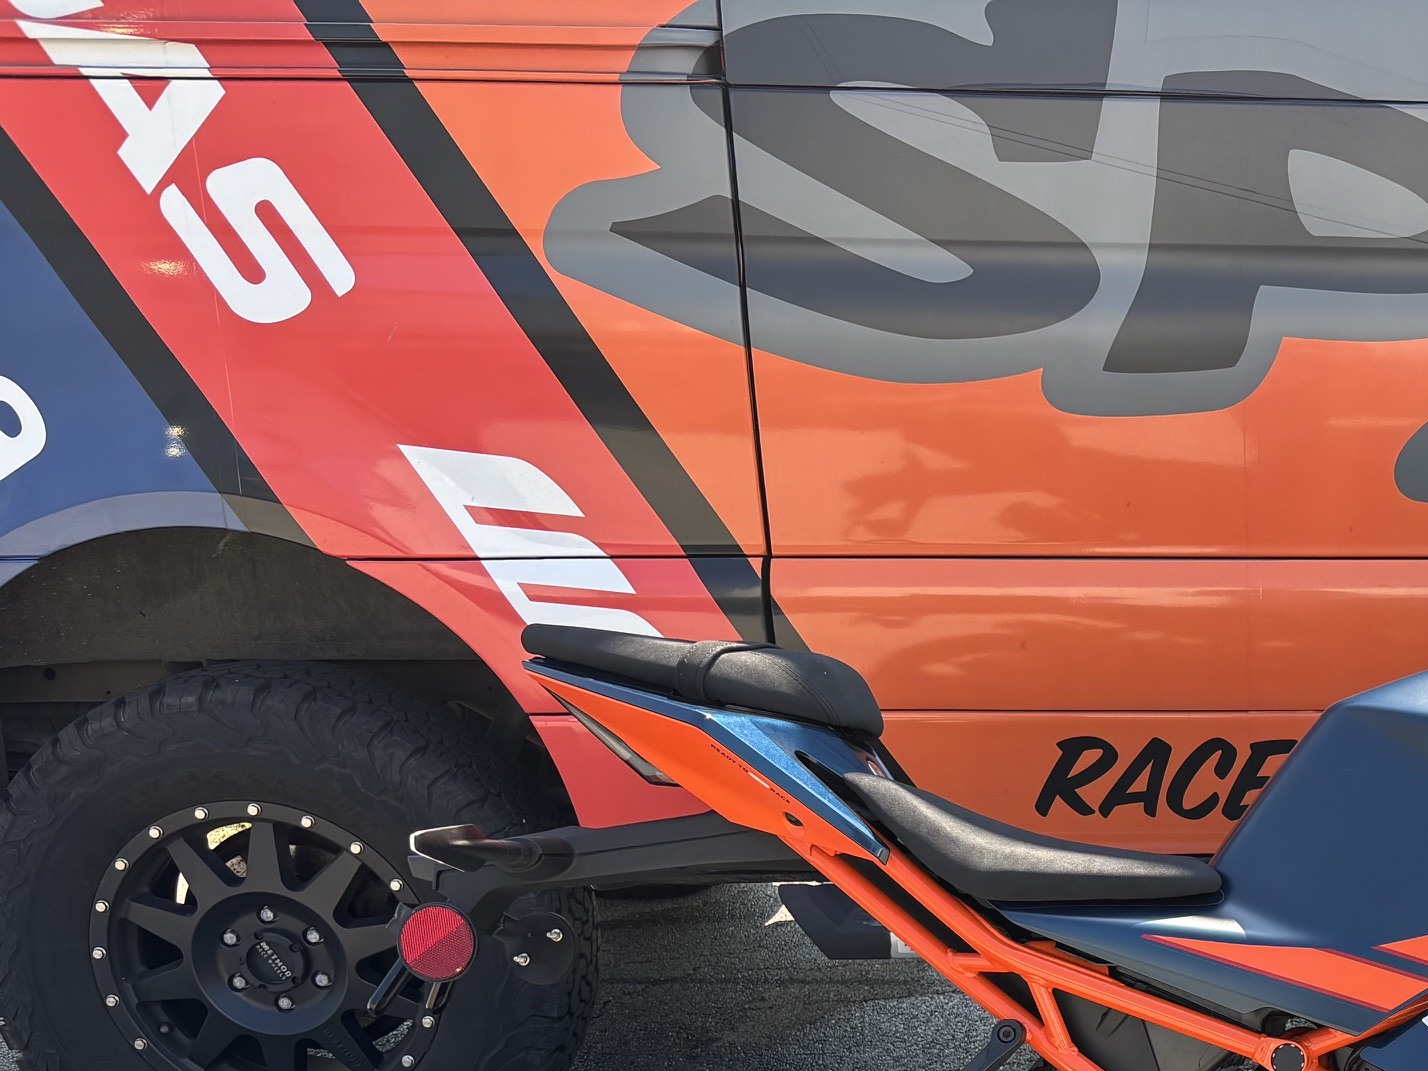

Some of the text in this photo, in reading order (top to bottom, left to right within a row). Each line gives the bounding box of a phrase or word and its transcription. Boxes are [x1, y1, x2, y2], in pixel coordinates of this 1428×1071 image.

[770, 787, 791, 804] RACE
[1034, 736, 1299, 822] RACE
[260, 941, 291, 977] METHOD
